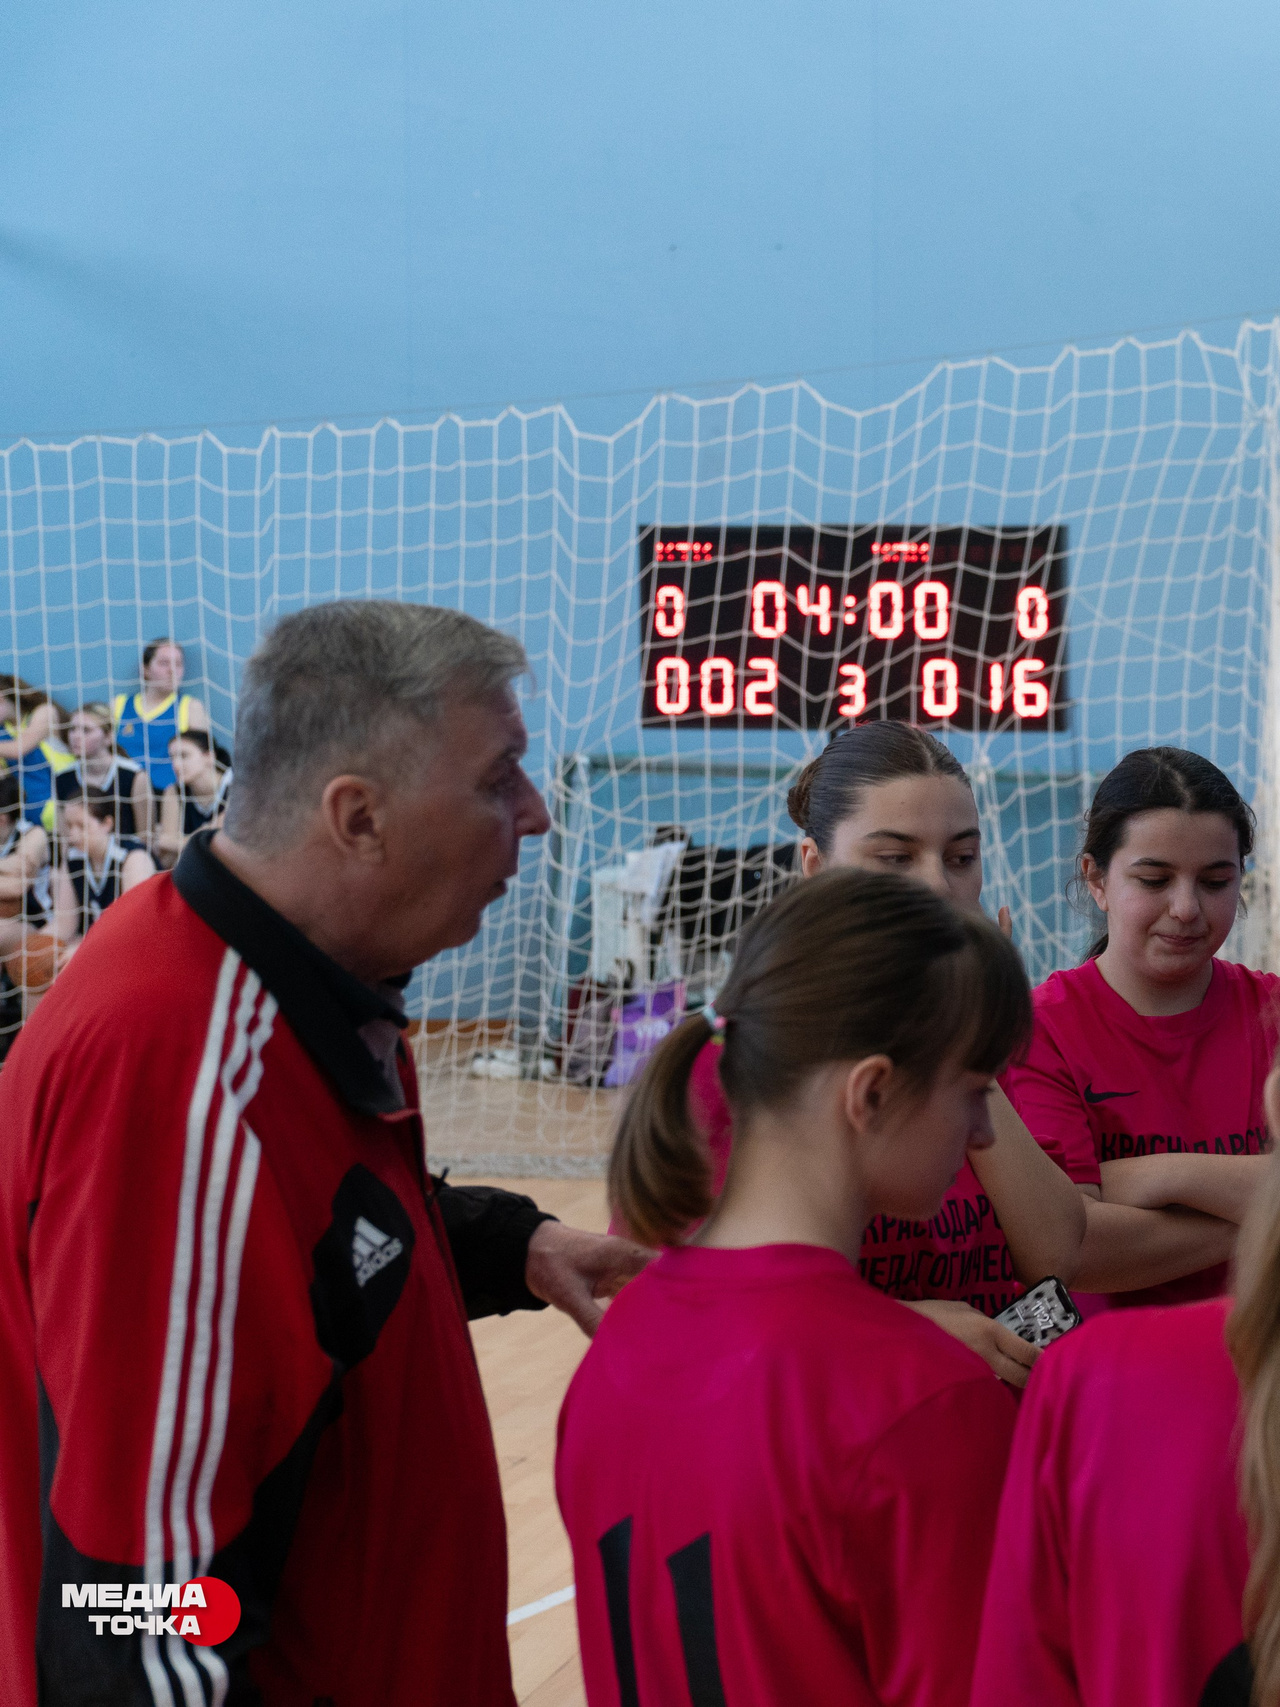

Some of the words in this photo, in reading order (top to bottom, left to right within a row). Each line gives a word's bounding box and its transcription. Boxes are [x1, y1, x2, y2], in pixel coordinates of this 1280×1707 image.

[655, 585, 685, 637] 0
[752, 580, 950, 640] 04:00
[1017, 586, 1049, 640] 0
[655, 657, 778, 716] 002
[838, 664, 867, 717] 3
[1031, 1300, 1054, 1330] 11:27
[597, 1515, 729, 1707] 11
